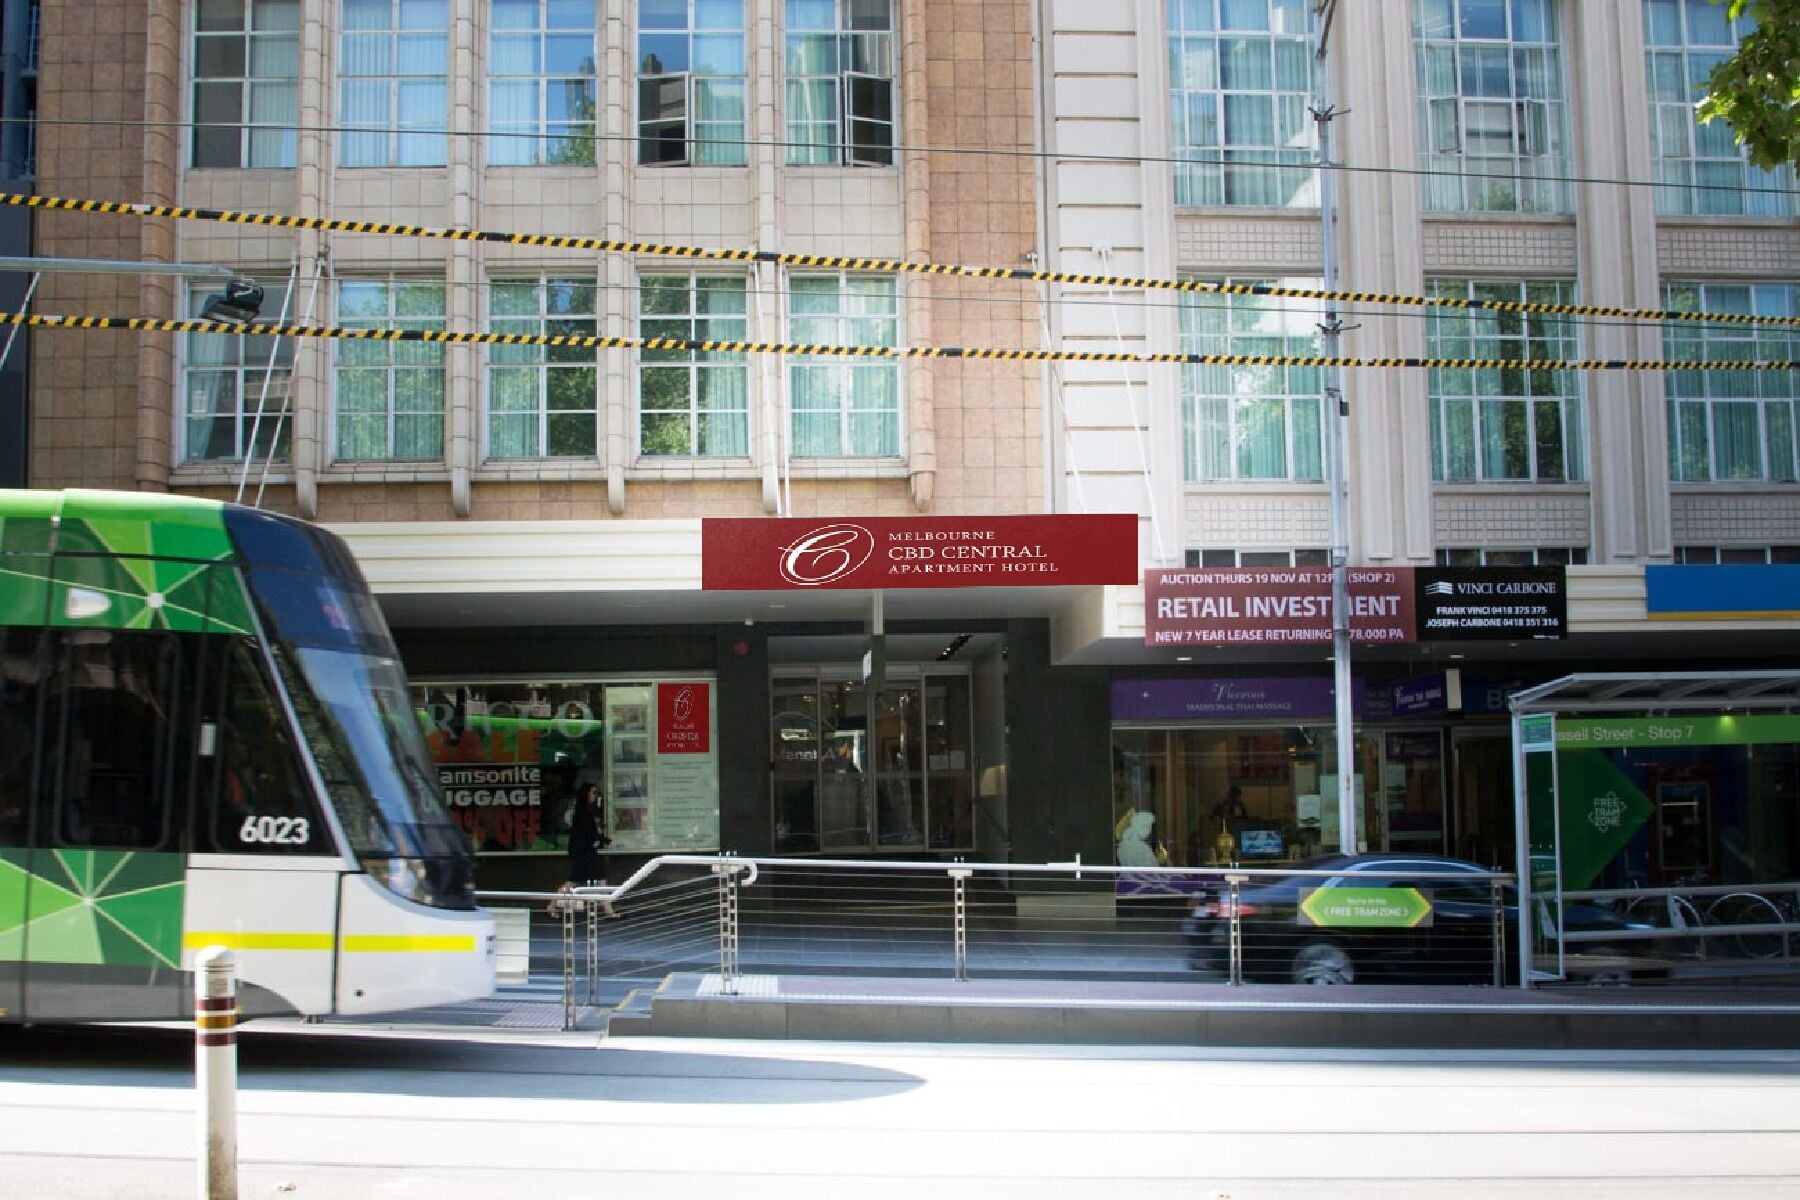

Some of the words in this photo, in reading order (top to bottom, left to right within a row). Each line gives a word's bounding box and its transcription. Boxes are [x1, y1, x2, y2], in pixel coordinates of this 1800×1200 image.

[888, 531, 995, 541] MELBOURNE
[888, 546, 935, 560] CBD
[941, 545, 1048, 559] CENTRAL
[888, 563, 995, 574] APARTMENT
[1001, 562, 1059, 572] HOTEL
[1160, 574, 1214, 584] AUCTION
[1216, 574, 1252, 583] THURS
[1255, 574, 1268, 583] 19
[1271, 574, 1295, 583] NOV
[1299, 573, 1312, 583] AT
[1348, 572, 1382, 583] (SHOP
[1385, 572, 1395, 583] 2)
[1458, 582, 1493, 594] VINCI
[1496, 582, 1557, 593] CARBONE
[1157, 598, 1240, 618] RETAIL
[1155, 631, 1182, 642] NEW
[1186, 631, 1192, 641] 7
[1195, 630, 1225, 641] YEAR
[1228, 630, 1263, 640] LEASE
[1266, 629, 1332, 640] RETURNING
[1389, 628, 1404, 639] PA
[1557, 729, 1589, 741] ssell
[1593, 727, 1635, 740] Street
[1648, 726, 1682, 741] Stop
[1685, 725, 1693, 738] 7
[440, 766, 541, 784] amsonite
[446, 789, 541, 806] GGAGE
[240, 815, 310, 844] 6023
